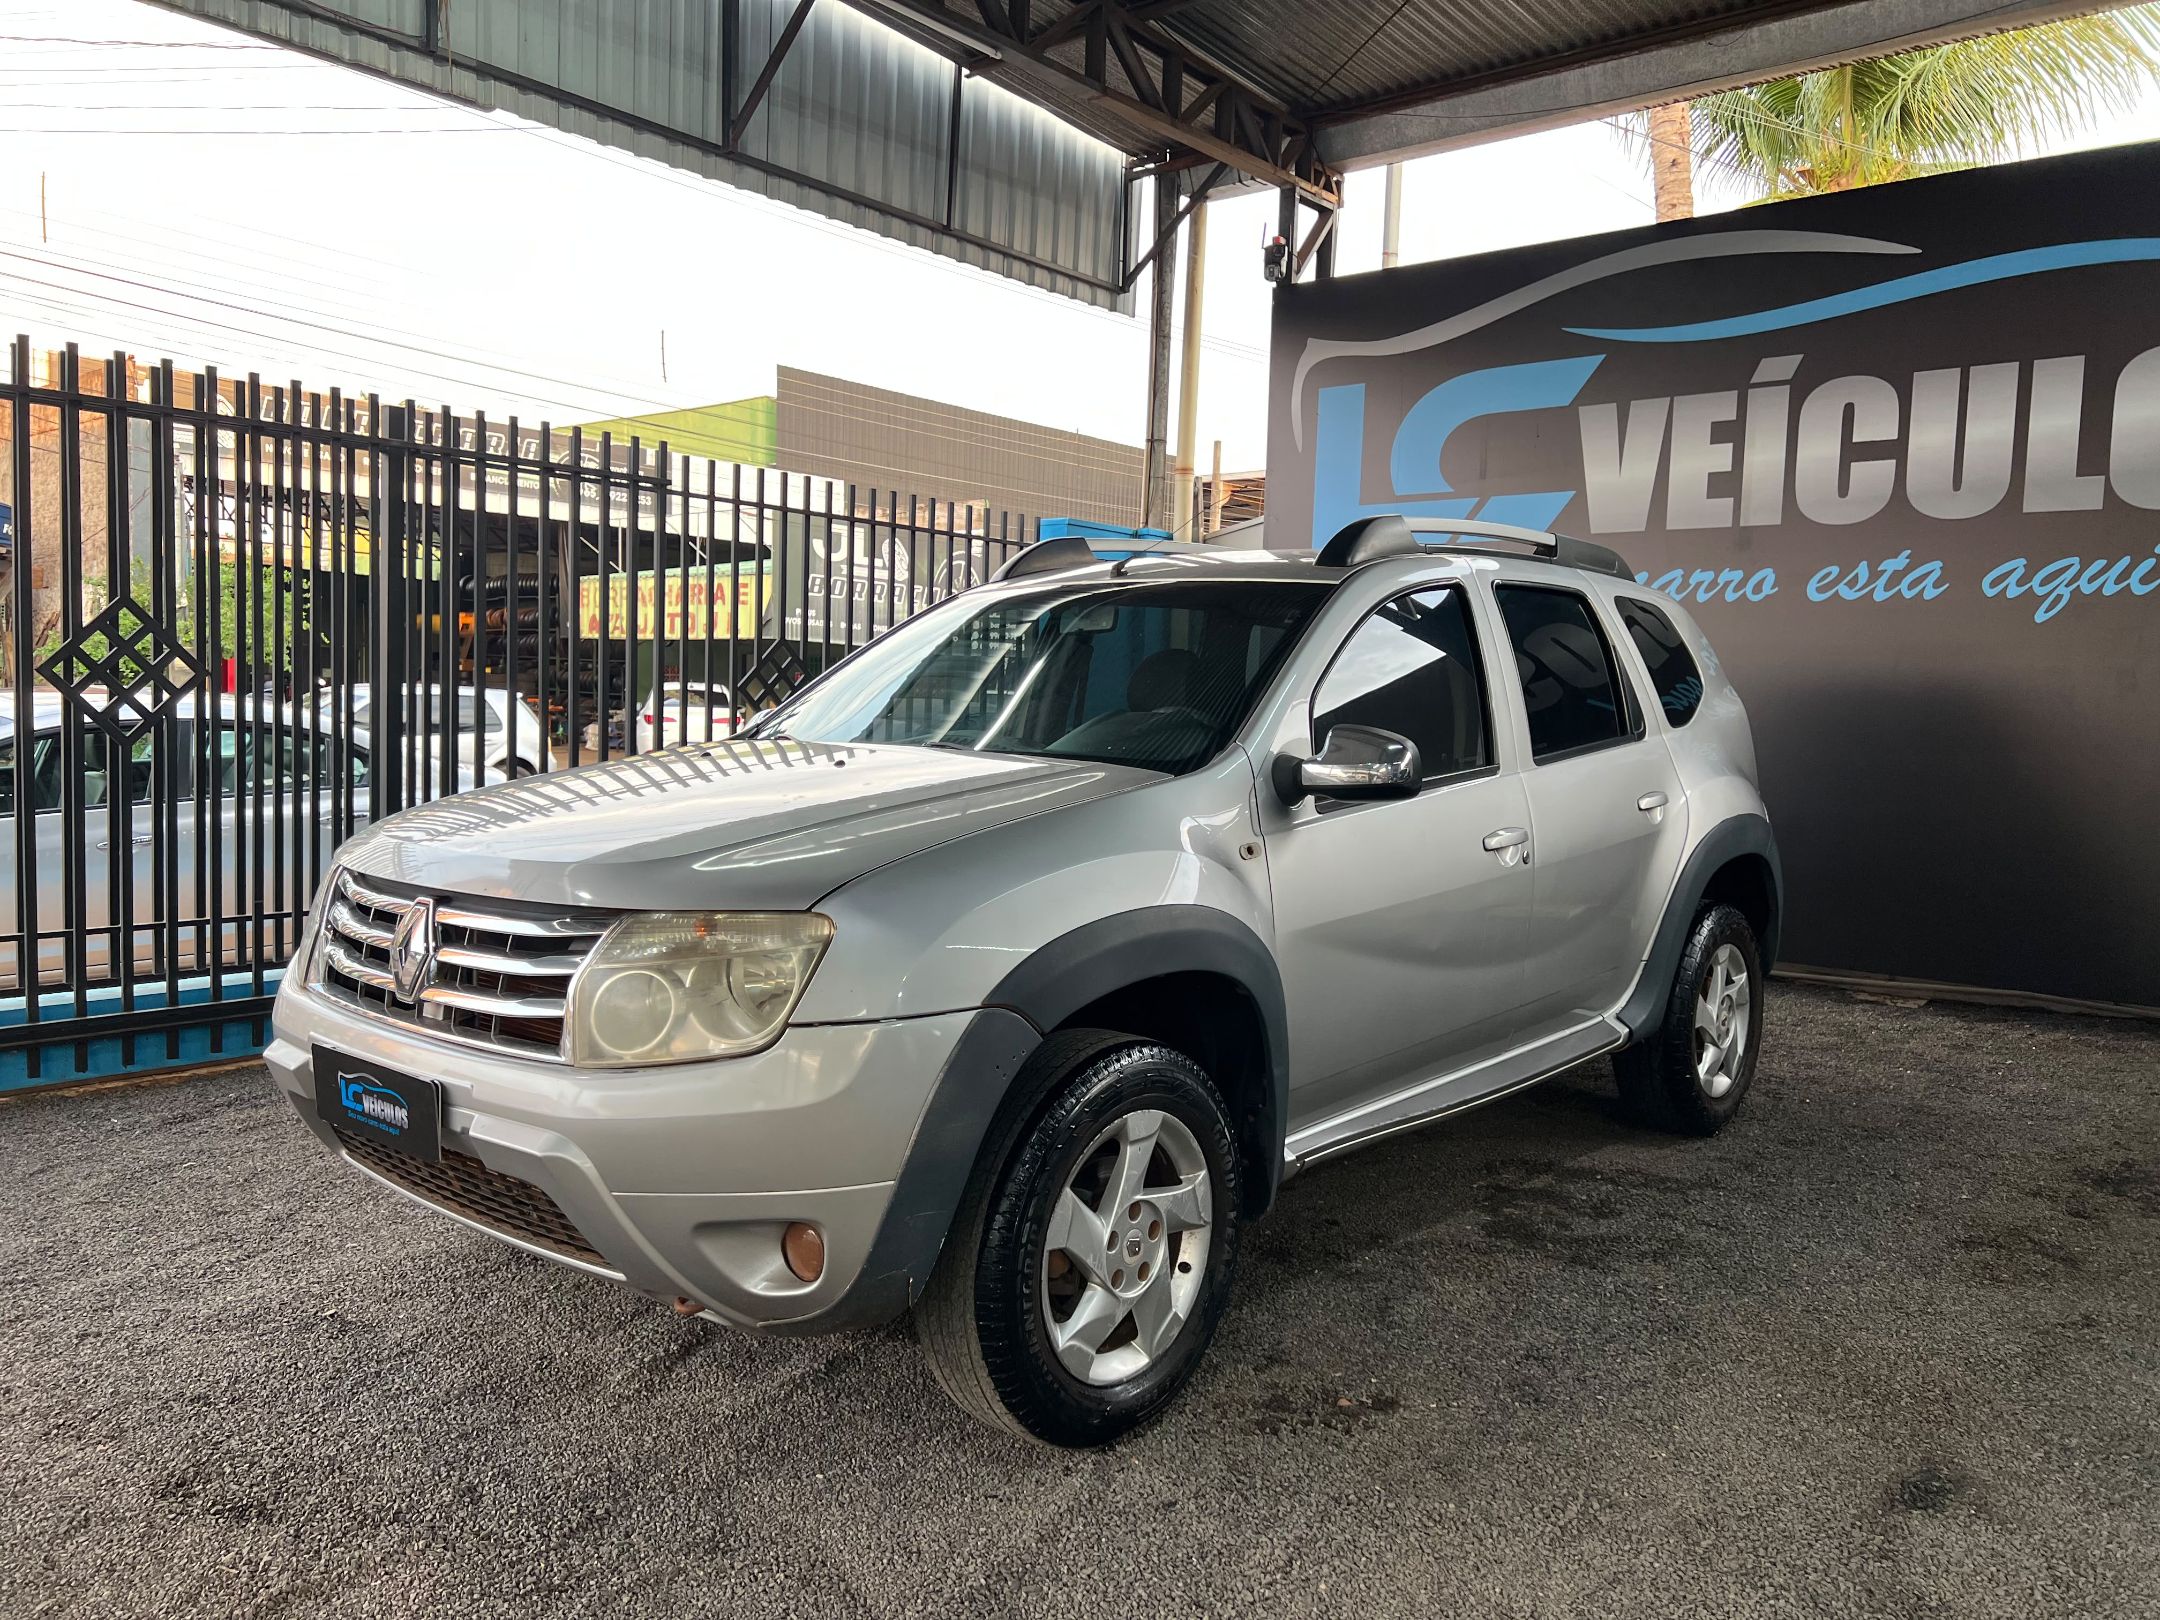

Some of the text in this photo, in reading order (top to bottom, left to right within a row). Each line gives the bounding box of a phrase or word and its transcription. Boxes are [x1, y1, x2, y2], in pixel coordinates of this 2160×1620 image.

[1312, 353, 1606, 545] LC
[1635, 566, 1778, 603] arro
[1806, 549, 1950, 603] esta
[340, 1078, 364, 1112] LC
